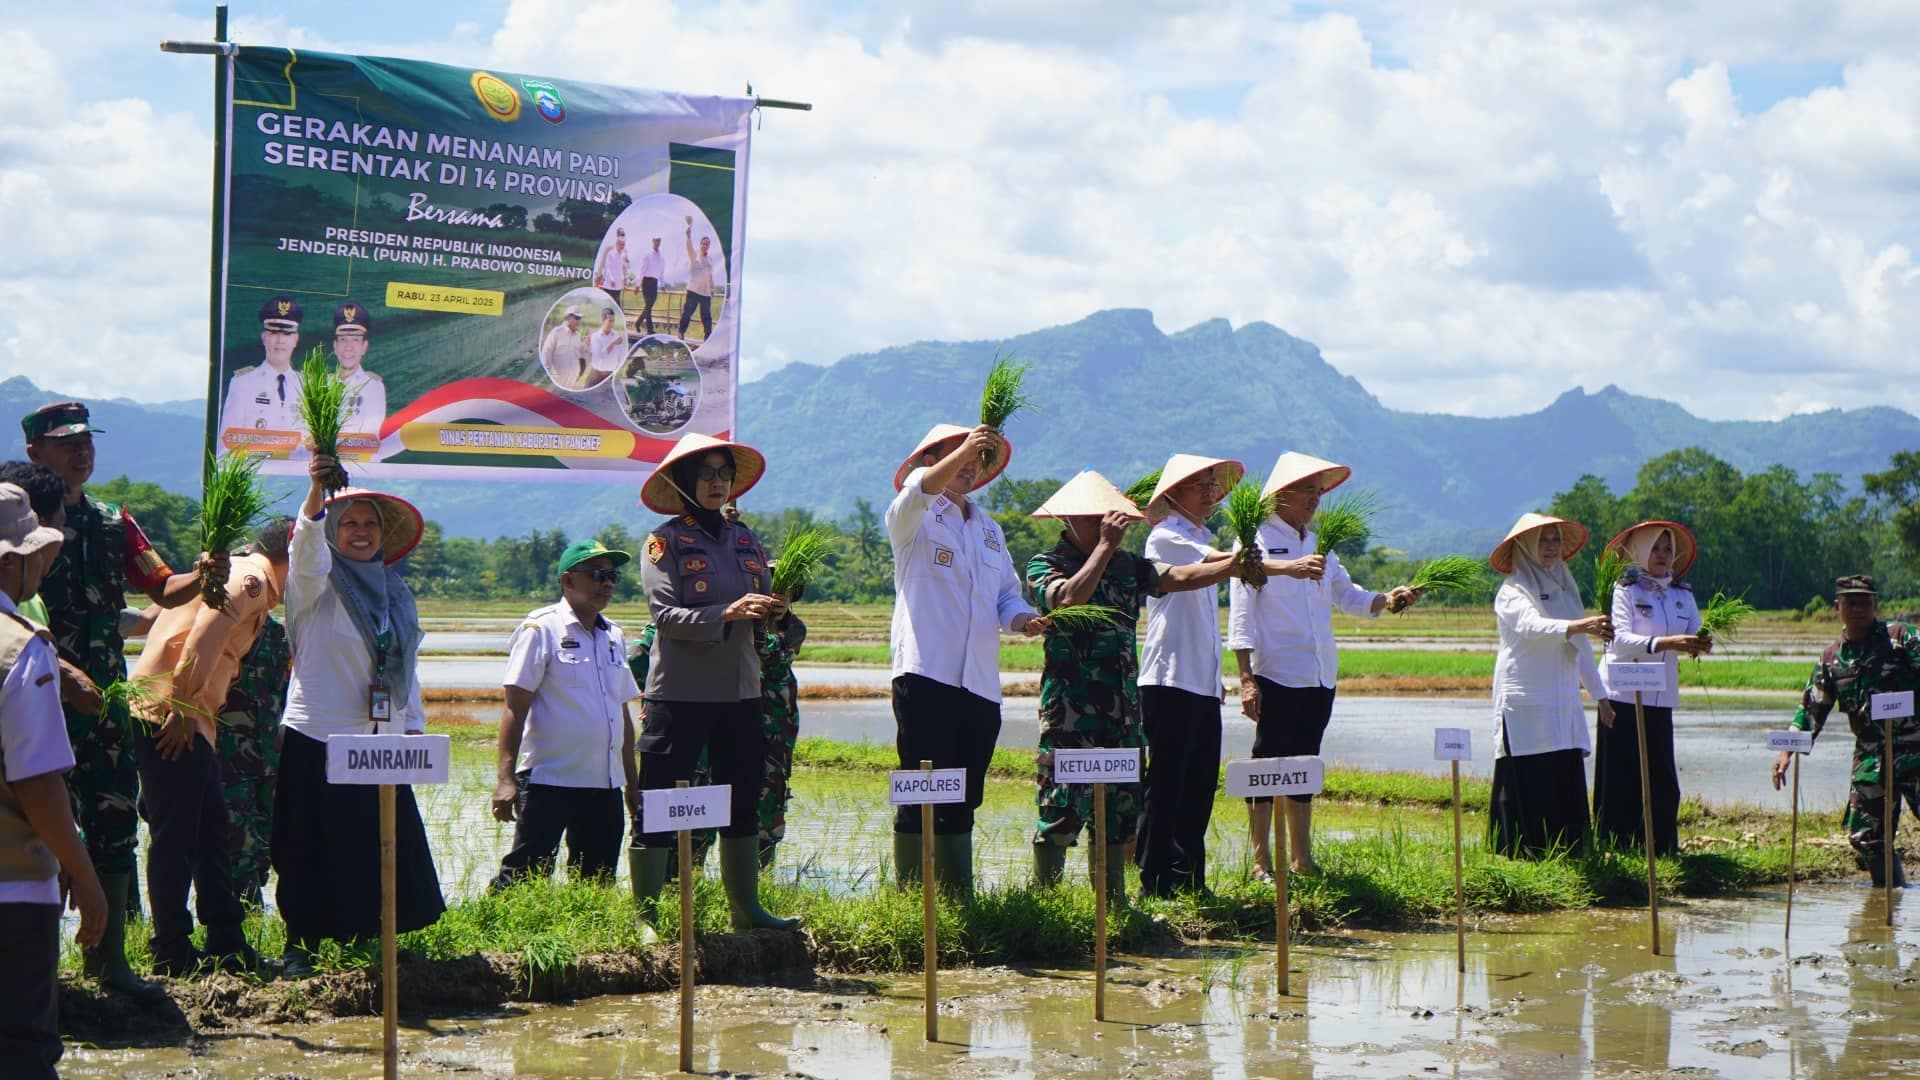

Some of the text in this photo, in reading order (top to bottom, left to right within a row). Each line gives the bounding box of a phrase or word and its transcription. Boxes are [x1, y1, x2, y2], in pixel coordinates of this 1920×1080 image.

[257, 112, 620, 178] GERAKAN MENANAM PADI
[263, 141, 613, 204] SERENTAK DI 14 PROVINSI
[406, 192, 504, 228] Bersama
[325, 226, 562, 263] PRESIDEN REPUBLIK INDONESIA
[278, 238, 592, 280] JENDERAL (PURN) H. PRABOWO SUBIANTO
[430, 293, 440, 302] 23
[443, 295, 470, 305] APRIL
[472, 297, 494, 307] 2025
[439, 429, 466, 446] DINAS
[468, 430, 515, 448] PERTANIAN
[516, 431, 563, 450] KABUPATEN
[347, 749, 433, 770] DANRAMIL
[1060, 759, 1136, 773] KETUA DPRD
[894, 778, 961, 793] KAPOLRES
[1248, 771, 1308, 787] BUPATI
[668, 804, 706, 818] BBVet
